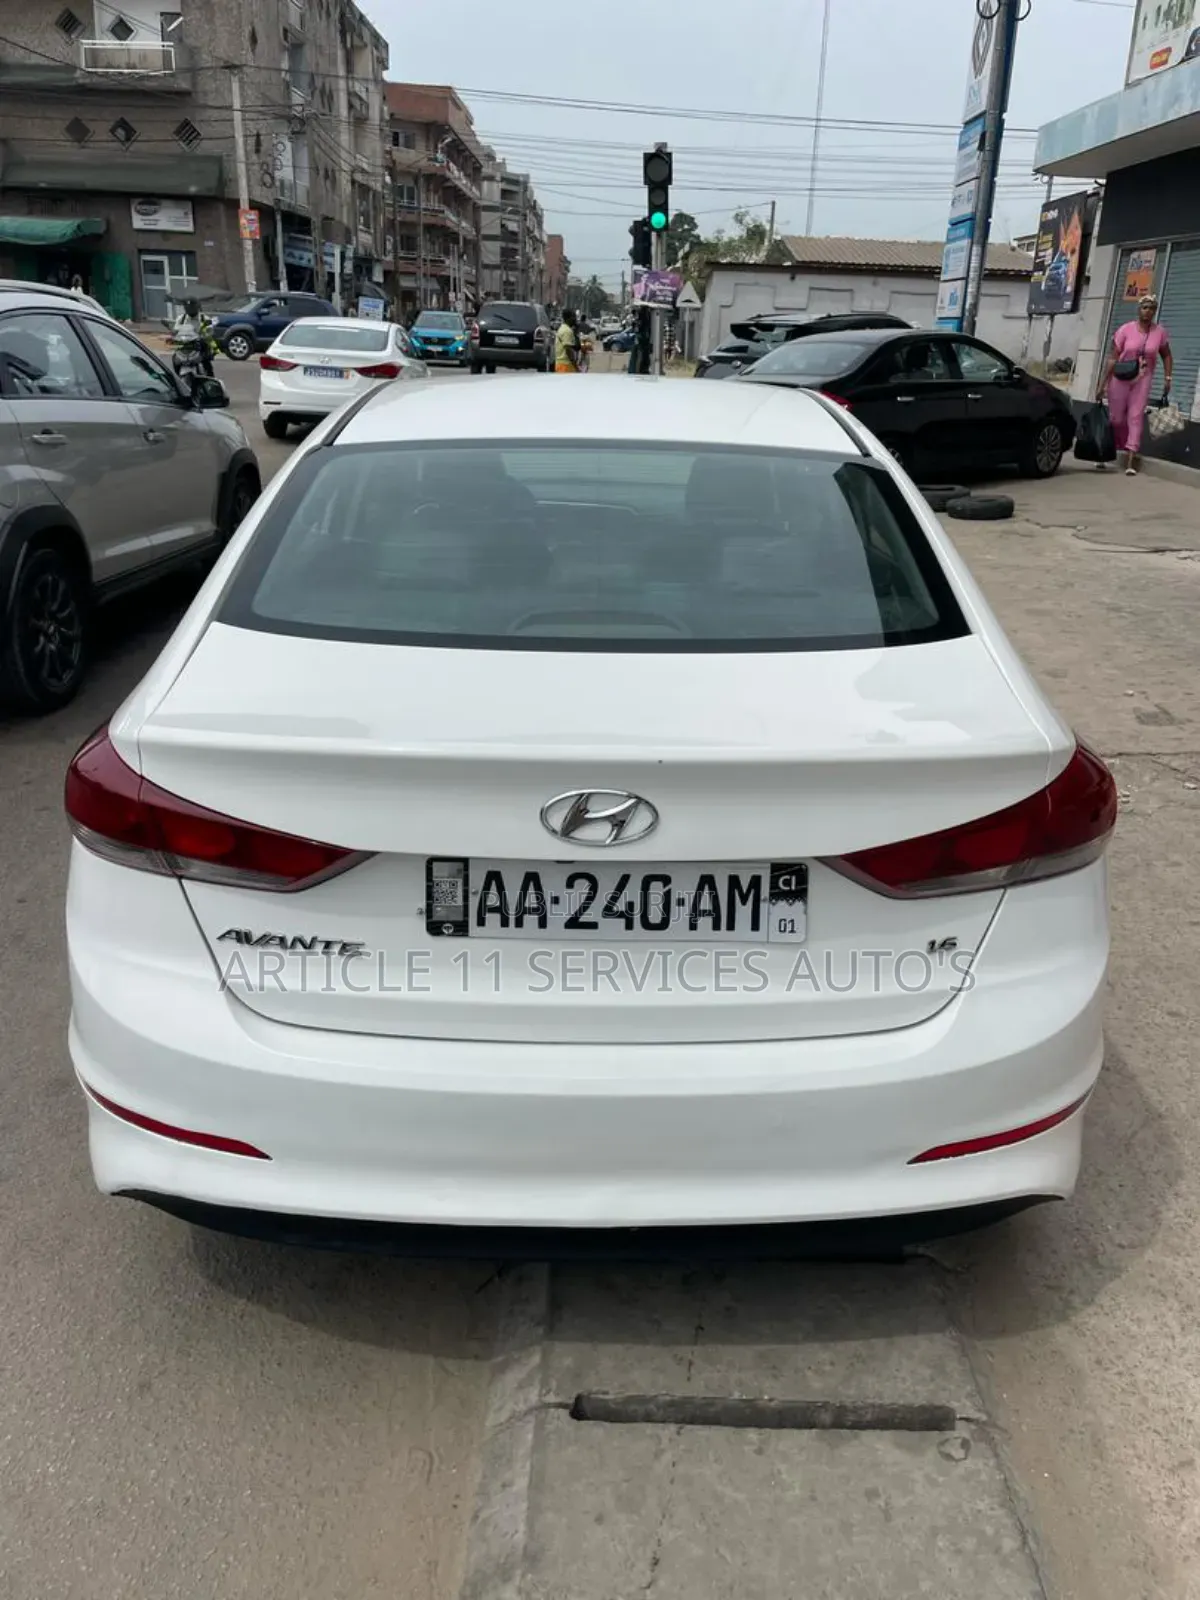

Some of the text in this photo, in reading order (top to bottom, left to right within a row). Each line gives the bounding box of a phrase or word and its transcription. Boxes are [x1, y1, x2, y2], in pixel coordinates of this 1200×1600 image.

[778, 874, 797, 891] CI
[778, 918, 797, 934] 01
[215, 928, 366, 956] AVANTE
